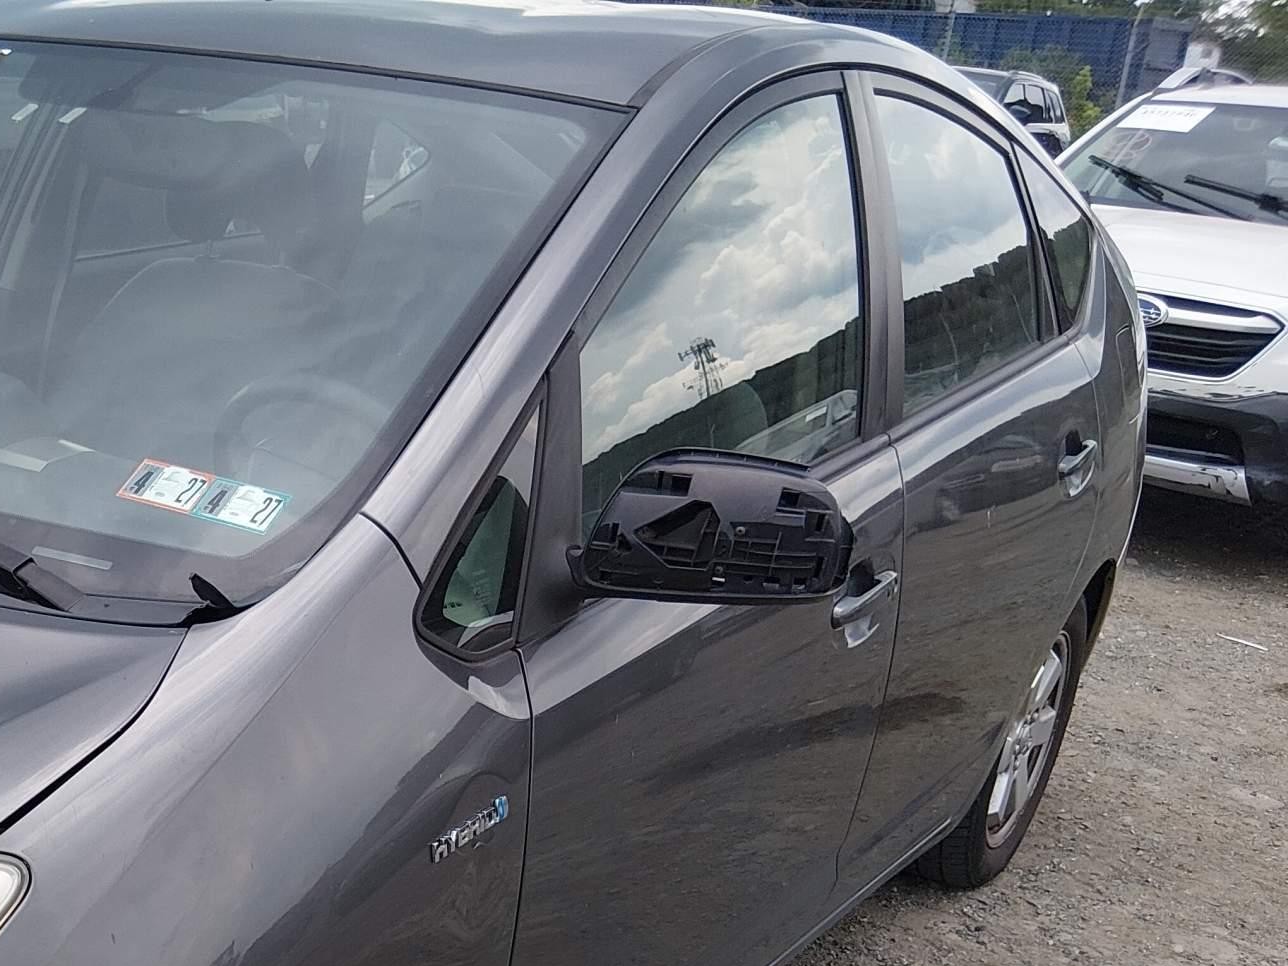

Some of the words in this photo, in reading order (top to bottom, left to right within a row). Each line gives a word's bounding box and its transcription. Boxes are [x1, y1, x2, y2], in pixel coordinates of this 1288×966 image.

[133, 470, 155, 496] 4
[173, 476, 208, 506] 27
[207, 489, 230, 515] 4
[249, 496, 283, 527] 27
